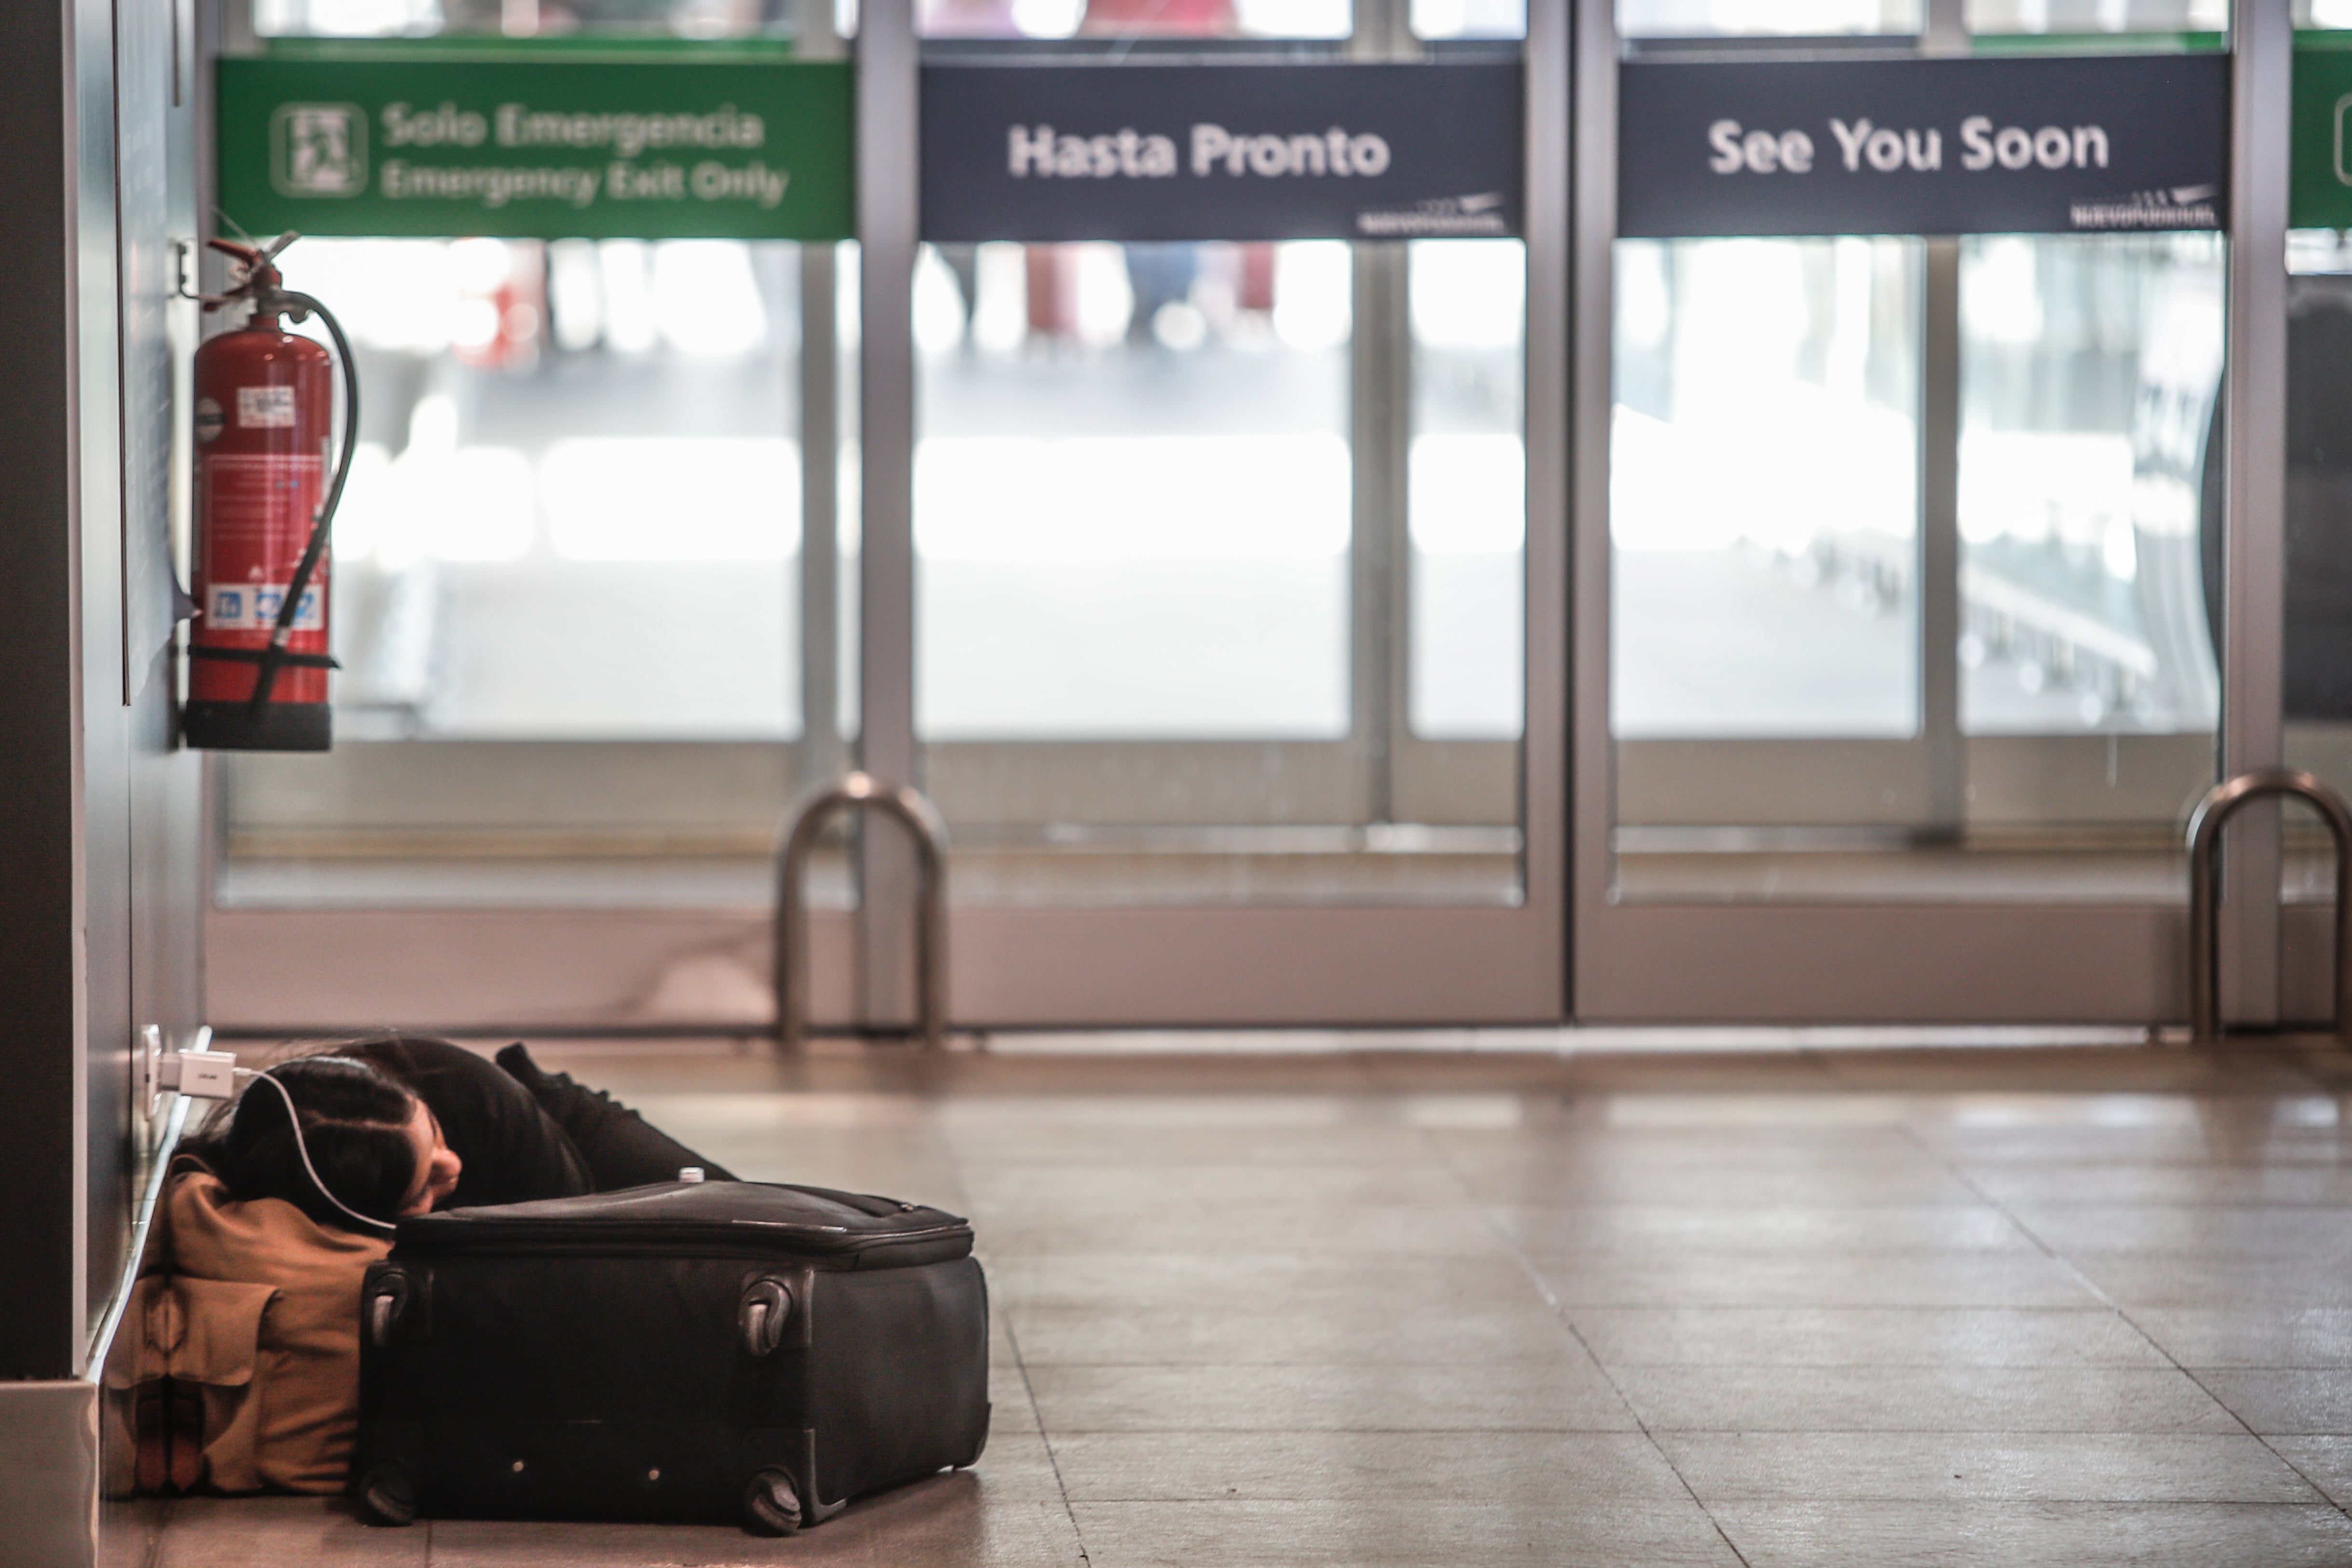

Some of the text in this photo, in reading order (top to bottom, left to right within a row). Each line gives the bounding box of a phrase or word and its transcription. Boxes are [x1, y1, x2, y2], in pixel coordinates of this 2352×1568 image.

[381, 101, 765, 158] Solo Emergencia
[1009, 124, 1391, 177] Hasta Pronto
[1709, 115, 2109, 174] See You Soon
[380, 159, 789, 208] Emergency Exit Only
